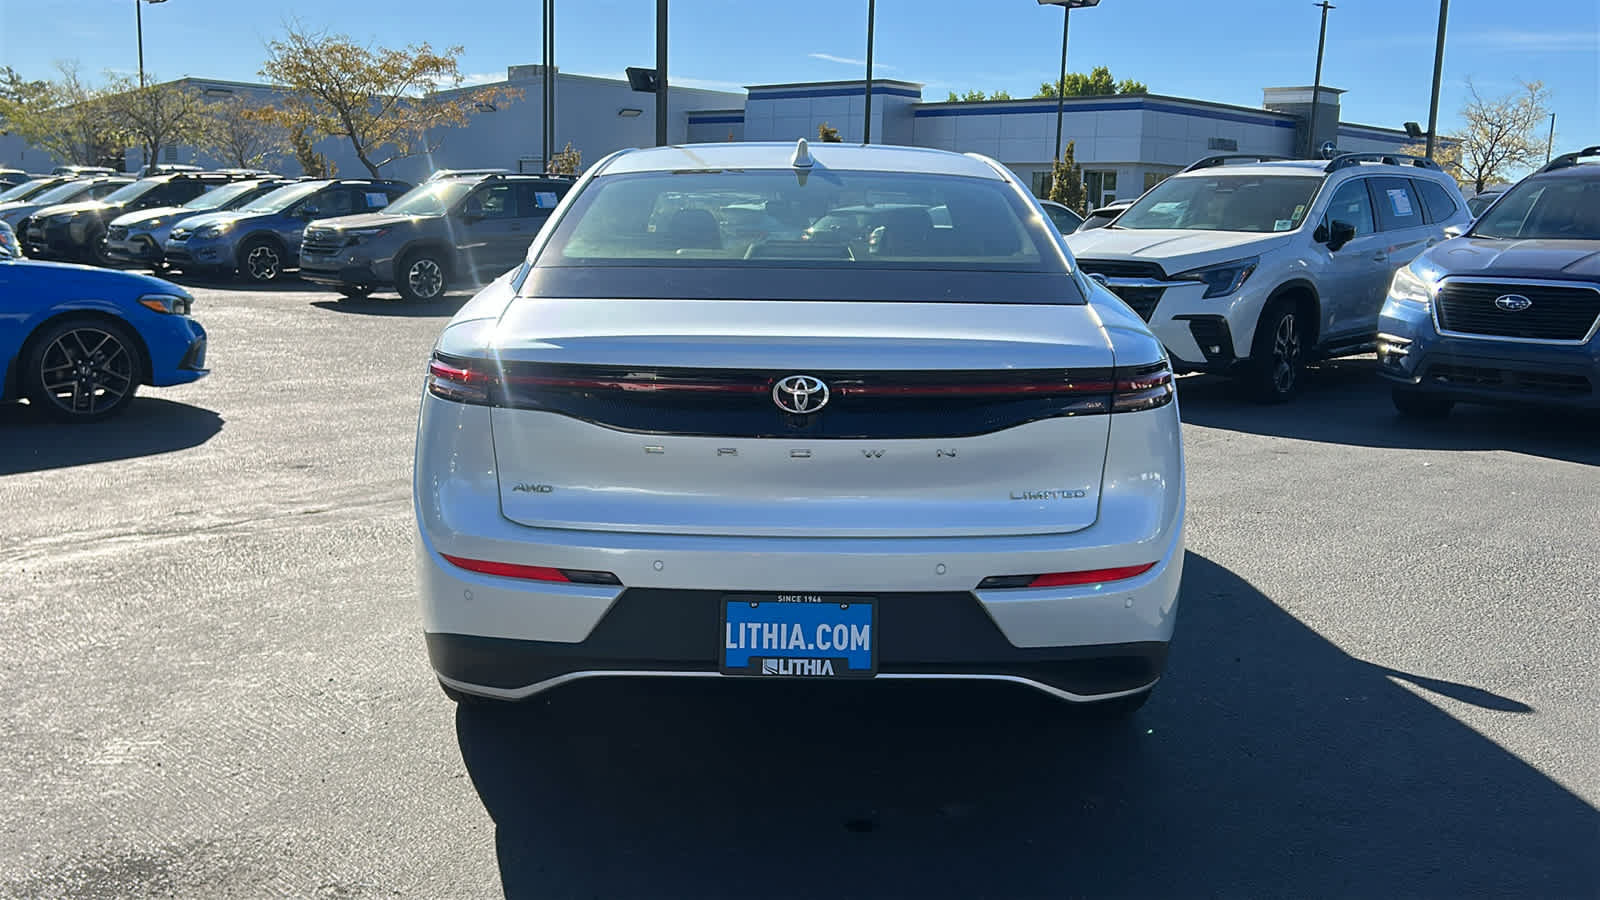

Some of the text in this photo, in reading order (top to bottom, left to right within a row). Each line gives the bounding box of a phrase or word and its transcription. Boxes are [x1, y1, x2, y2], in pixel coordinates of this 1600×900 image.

[644, 445, 959, 458] CROWN
[512, 482, 553, 493] AWD
[1009, 489, 1086, 500] LIMITED
[777, 595, 822, 603] SINCE 1946
[726, 622, 871, 651] LITHIA.COM
[778, 658, 835, 676] LITHIA
